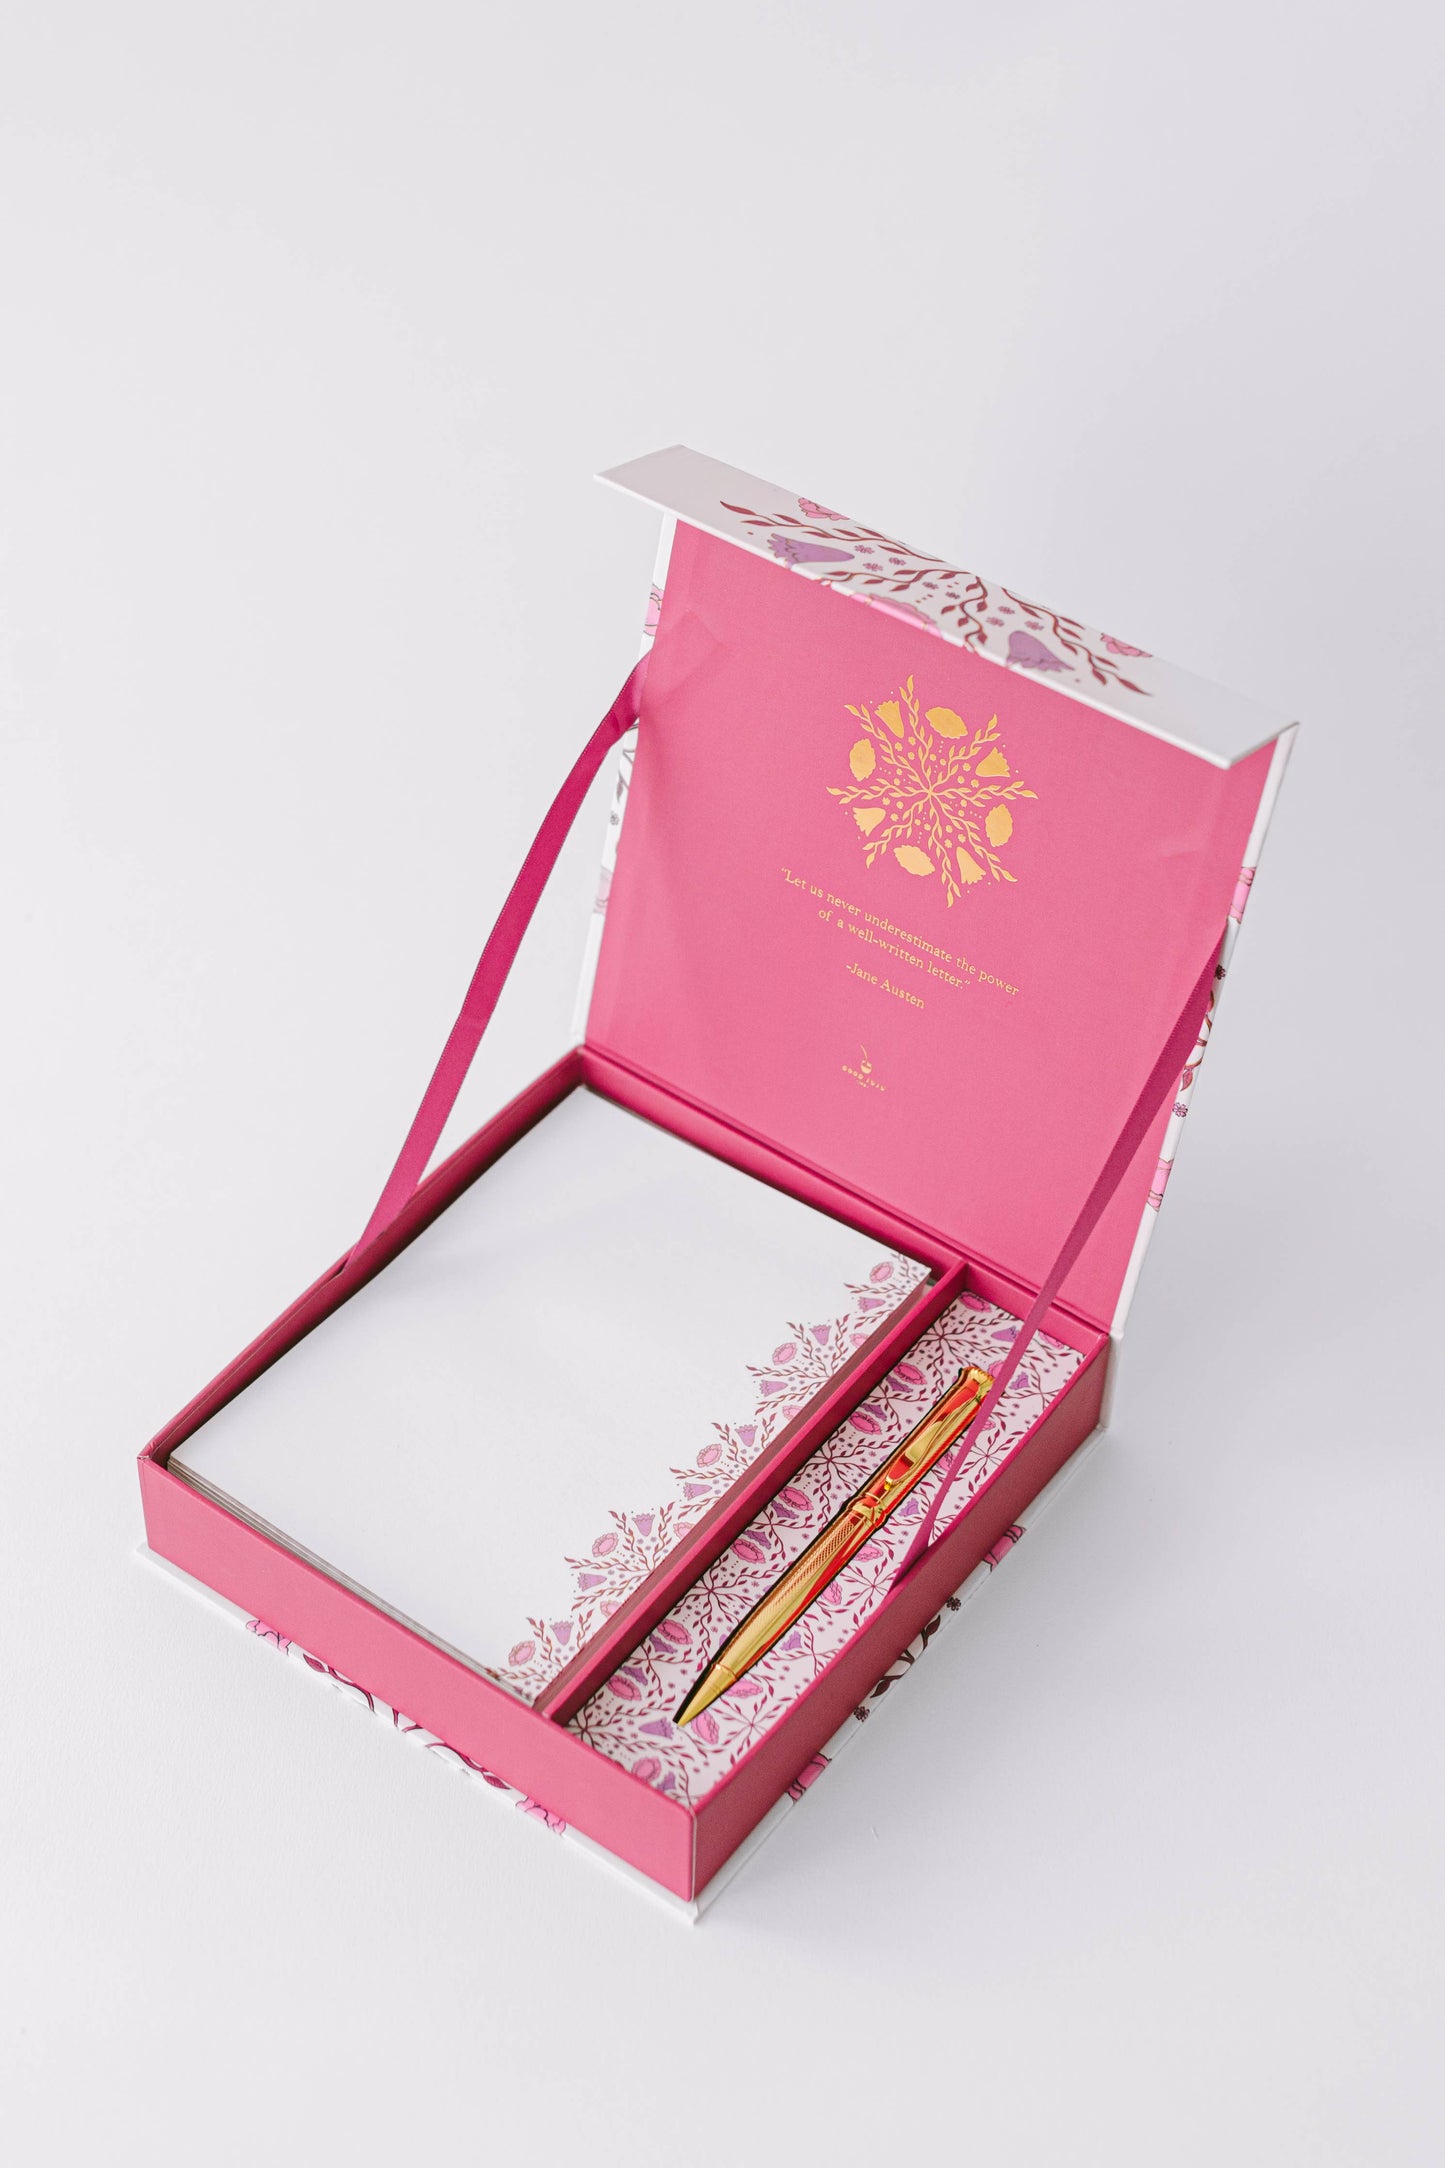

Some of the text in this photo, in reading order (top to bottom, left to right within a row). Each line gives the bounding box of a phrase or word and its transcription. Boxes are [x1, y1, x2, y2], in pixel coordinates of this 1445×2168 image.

[809, 884, 824, 899] us
[826, 893, 862, 917] never
[864, 912, 953, 963] underestimate
[956, 956, 977, 975] the
[977, 968, 1020, 996] power
[817, 908, 834, 922] of
[836, 917, 845, 929] a
[847, 923, 924, 969] well-written
[845, 962, 925, 1009] -Jane Austen
